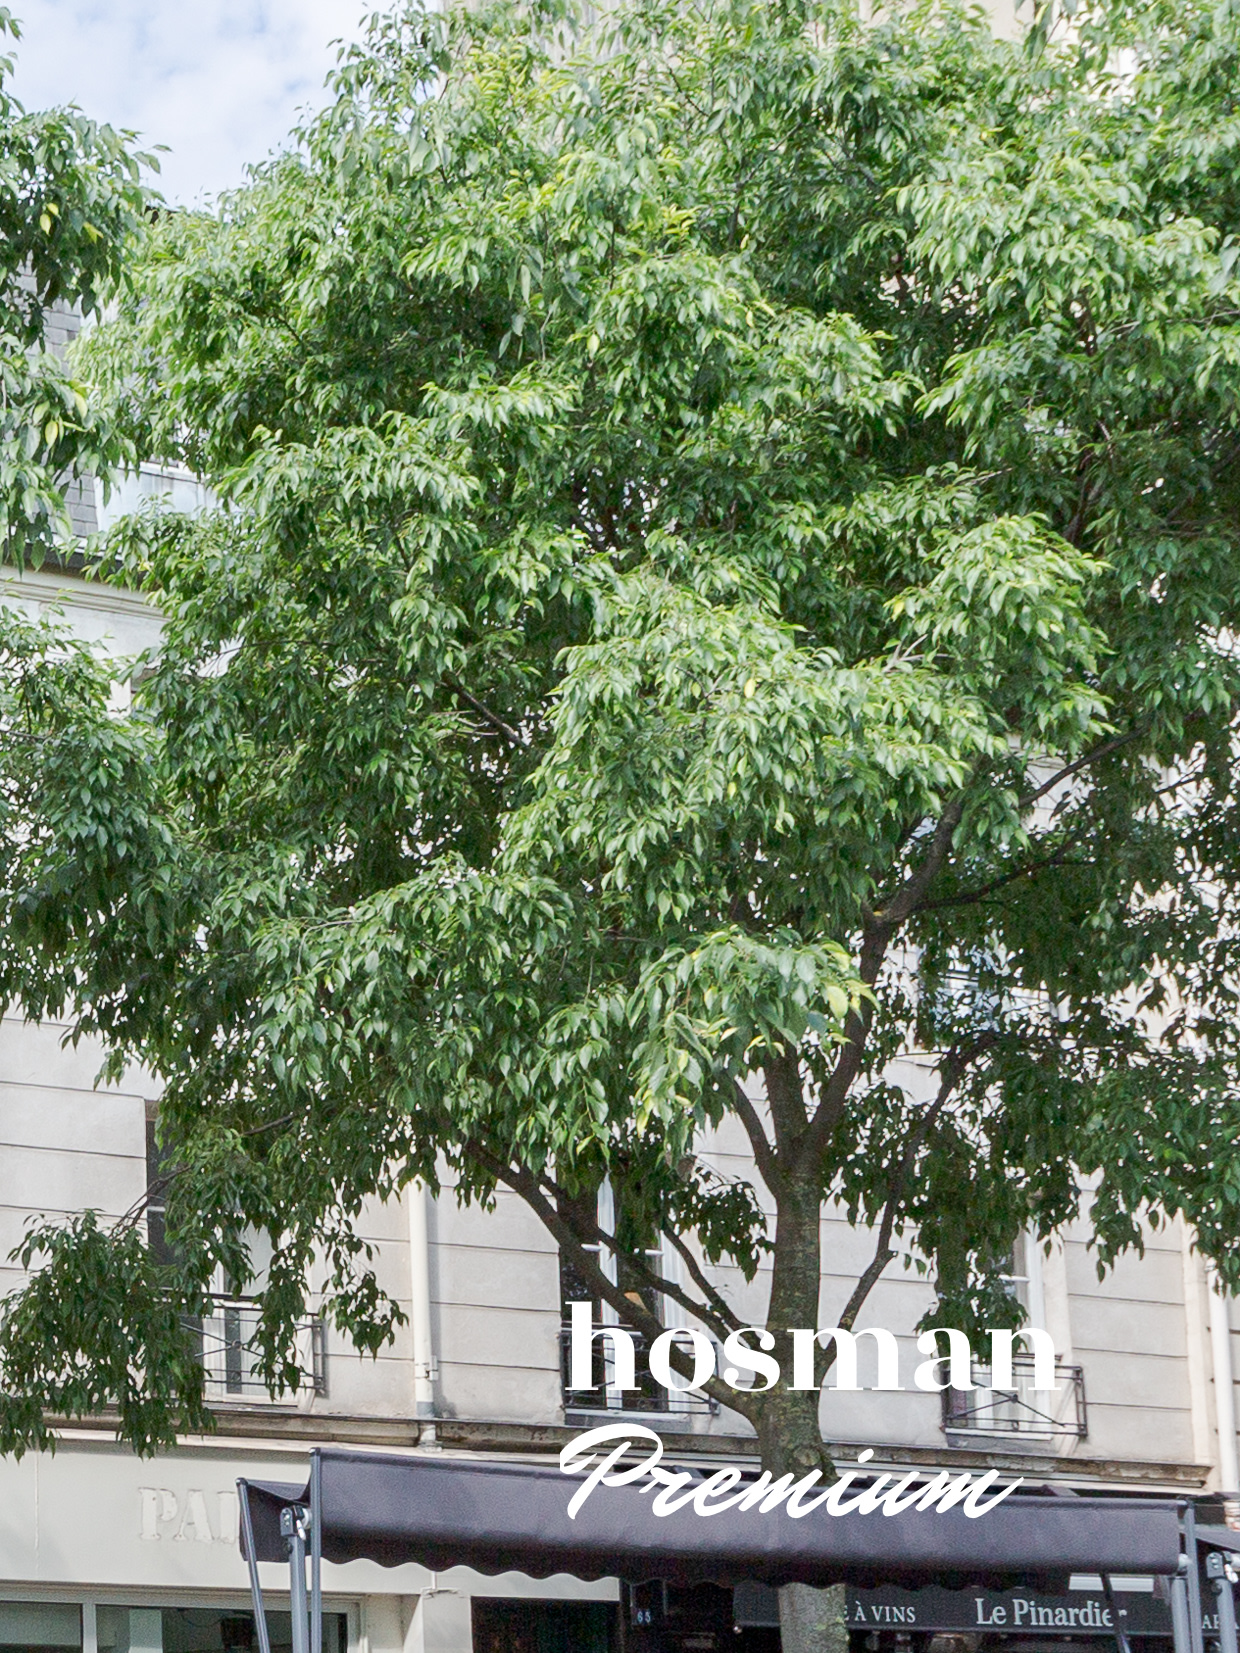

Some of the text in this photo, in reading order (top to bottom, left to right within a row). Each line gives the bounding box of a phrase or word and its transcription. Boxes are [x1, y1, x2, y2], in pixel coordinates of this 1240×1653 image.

[854, 1600, 867, 1622] À
[871, 1605, 916, 1623] VINS
[974, 1598, 1007, 1625] Le
